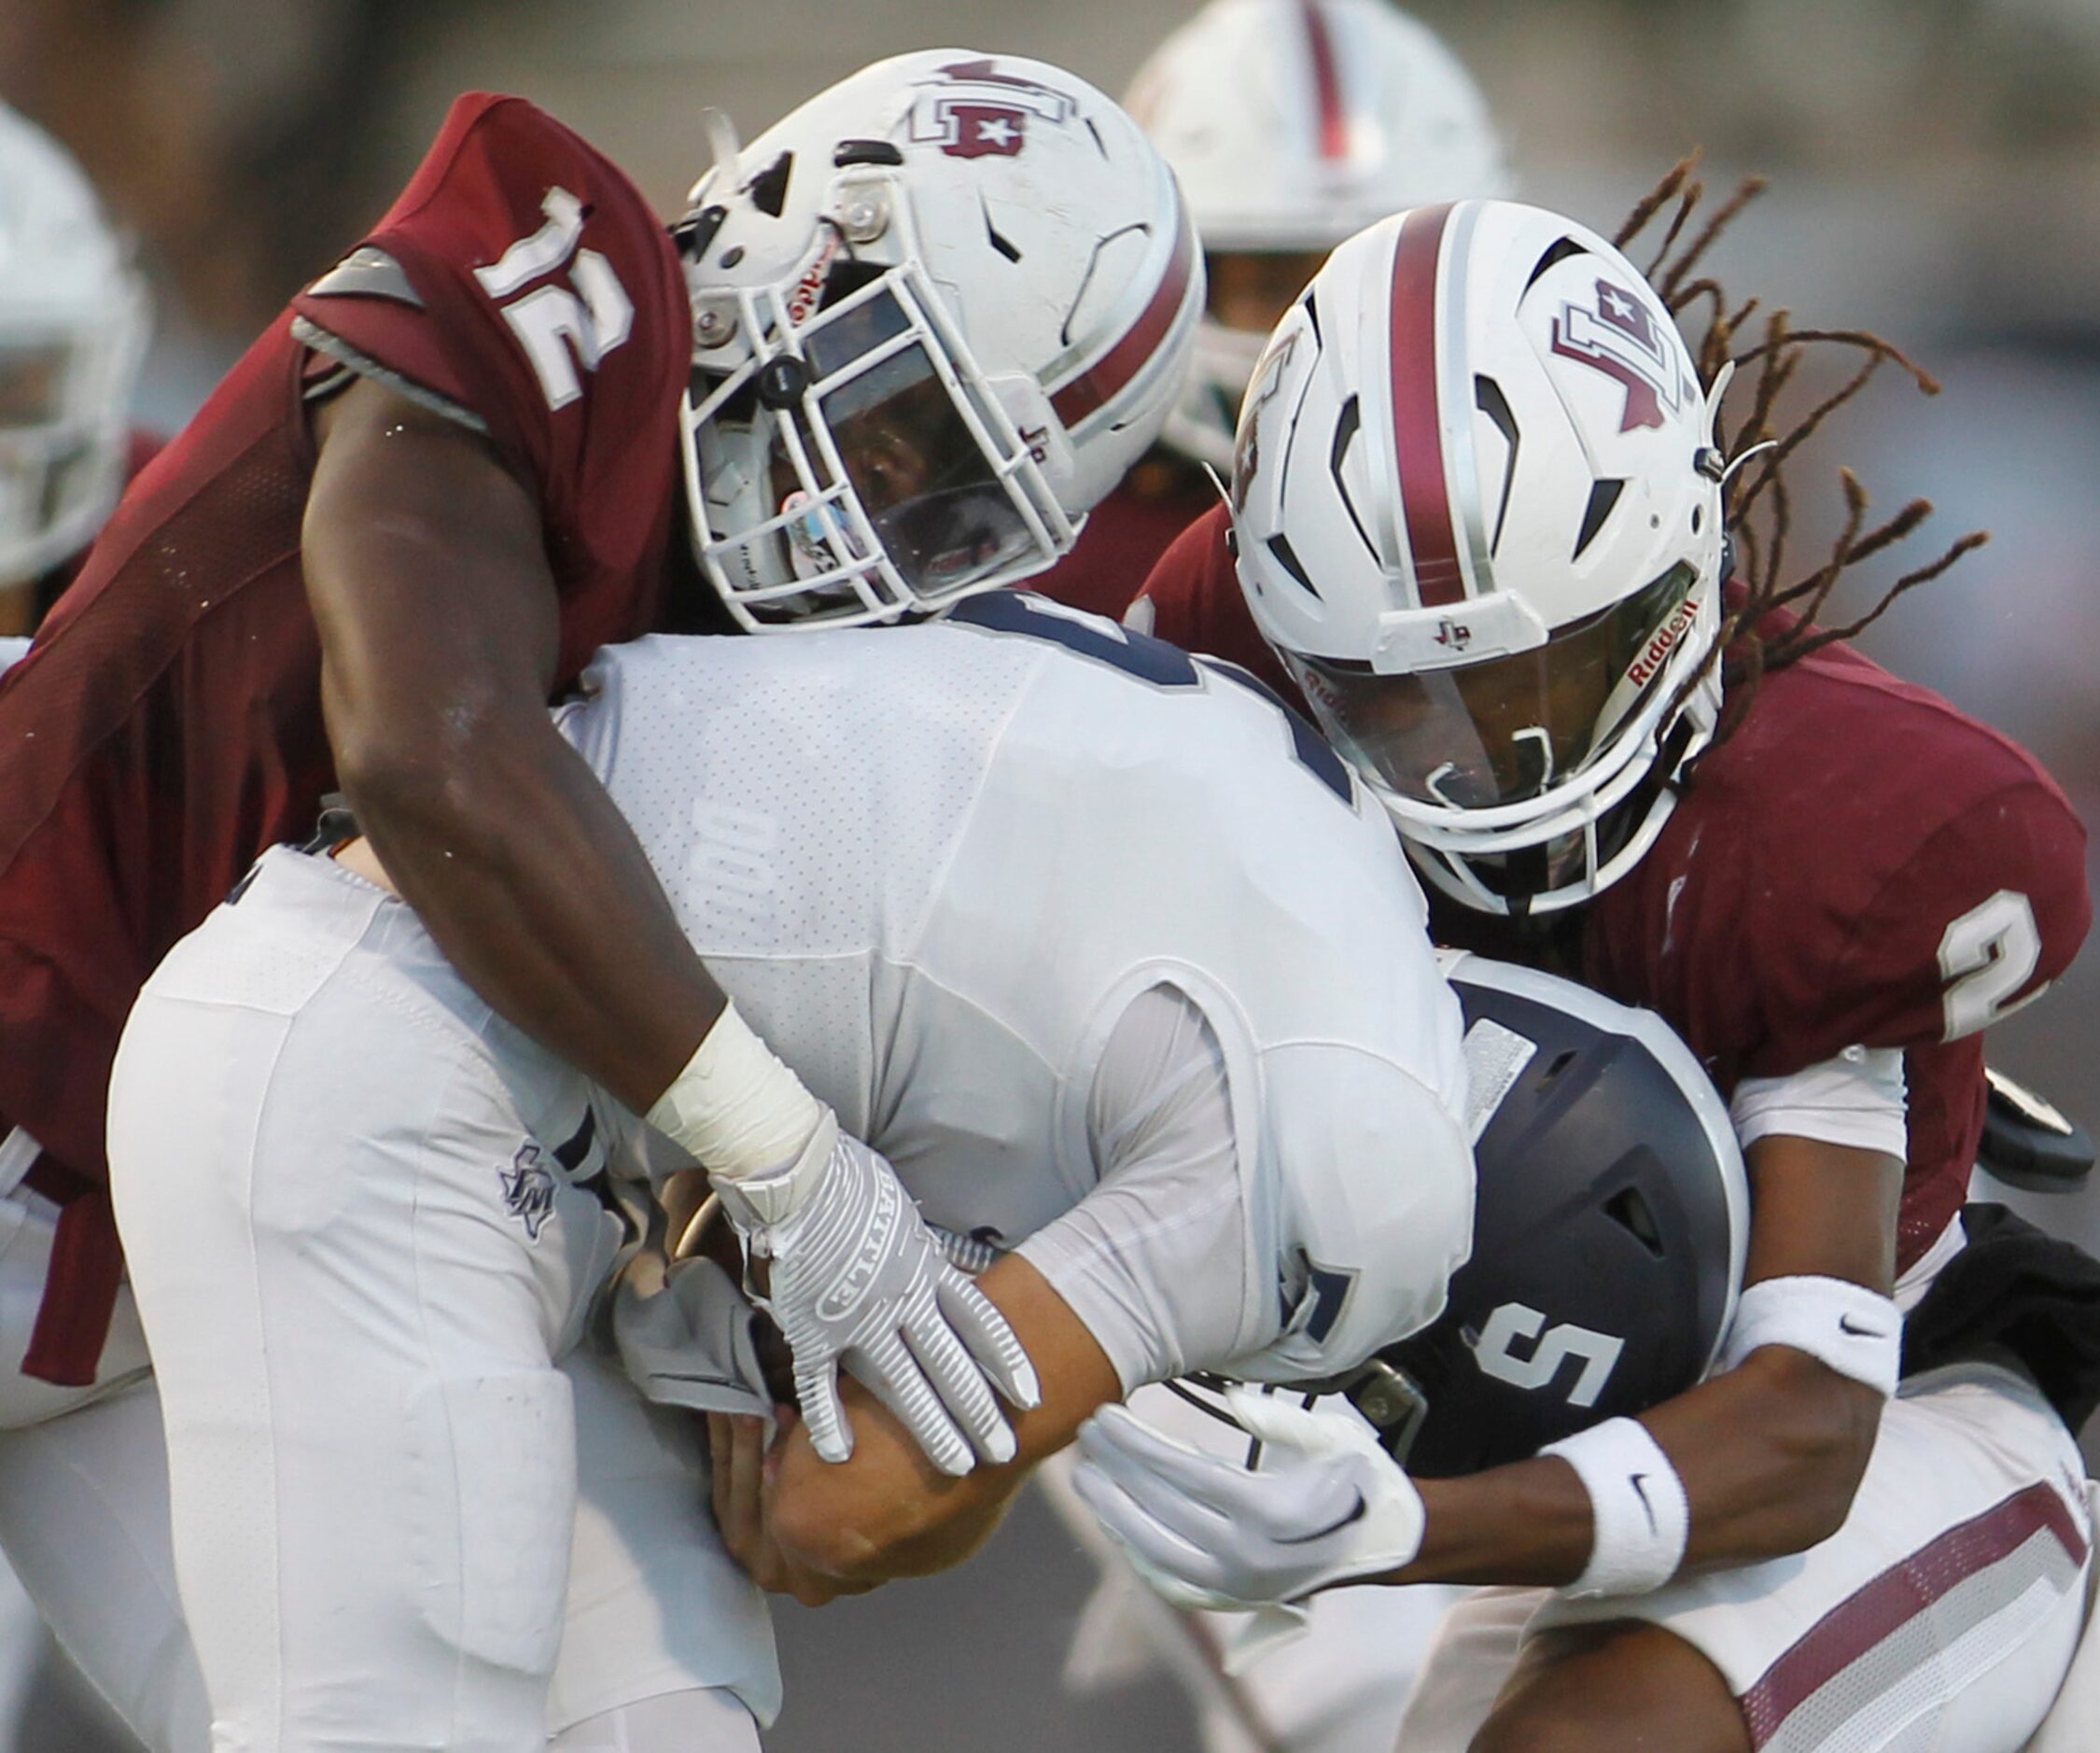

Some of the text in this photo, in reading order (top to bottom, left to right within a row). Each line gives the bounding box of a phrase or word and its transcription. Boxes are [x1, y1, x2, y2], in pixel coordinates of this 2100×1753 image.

[473, 186, 636, 412] 12
[1628, 599, 1700, 687] Riddell
[1938, 889, 2051, 1044] 2
[830, 1169, 896, 1307] BATTLE
[1474, 1301, 1626, 1408] 5
